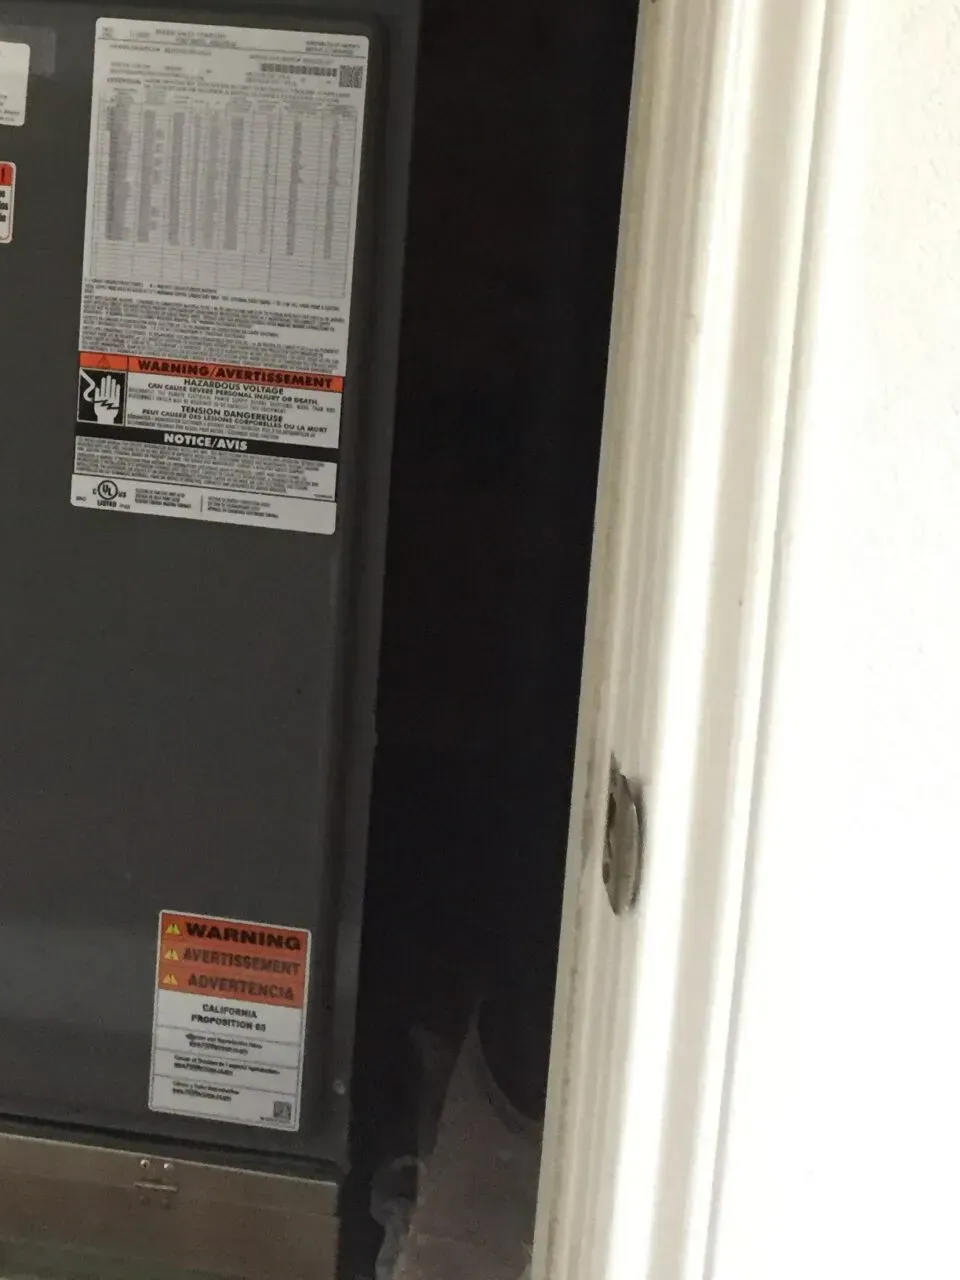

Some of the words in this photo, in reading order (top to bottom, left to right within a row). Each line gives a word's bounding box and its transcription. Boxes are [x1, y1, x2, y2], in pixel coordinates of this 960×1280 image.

[184, 378, 240, 391] HAZARDOUS
[243, 383, 284, 395] VOLTAGE
[181, 405, 221, 417] TENSION
[224, 409, 284, 422] DANGEREUSE
[164, 432, 248, 451] NOTICE/AVIS
[185, 922, 301, 951] WARNING
[183, 947, 300, 976] AVERTISSEMENT
[188, 972, 294, 1001] ADVERTENCIA
[202, 1003, 258, 1019] CALIFORNIA
[191, 1013, 253, 1030] PROPOSITION
